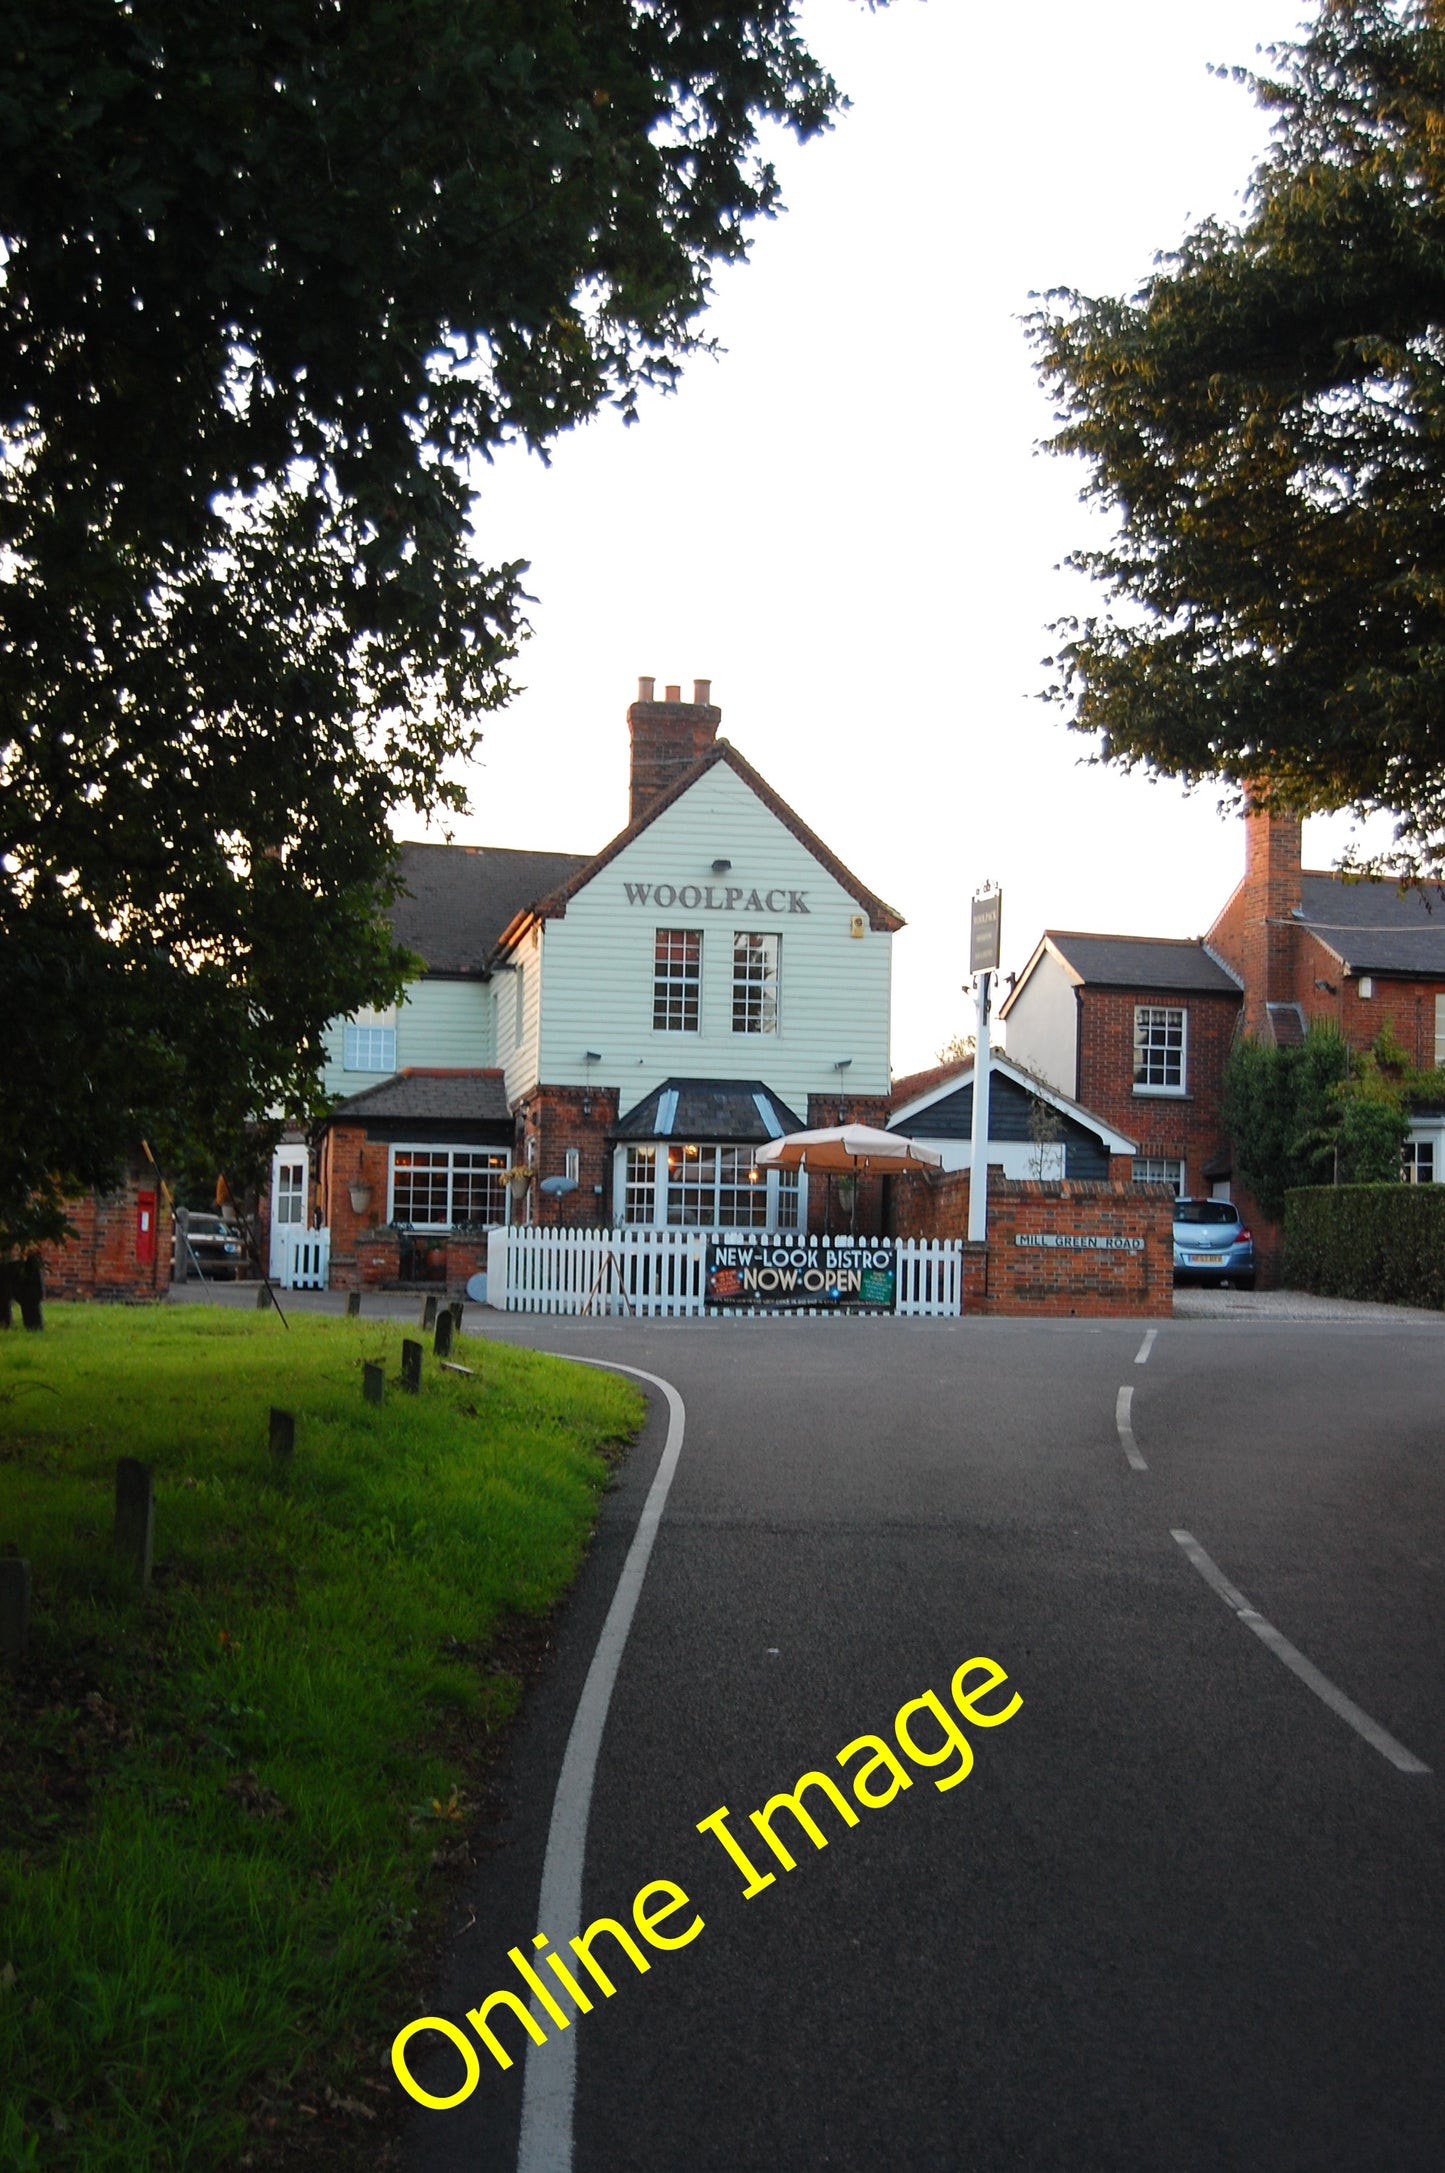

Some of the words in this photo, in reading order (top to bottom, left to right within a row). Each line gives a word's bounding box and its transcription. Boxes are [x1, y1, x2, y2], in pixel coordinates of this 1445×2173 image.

[623, 882, 811, 914] WOOLPACK
[1020, 1235, 1049, 1246] MILL
[1055, 1236, 1098, 1248] GREEN
[1106, 1237, 1140, 1248] ROAD
[715, 1247, 818, 1268] NEW-LOOK
[743, 1267, 798, 1292] NOW
[803, 1269, 861, 1292] OPEN
